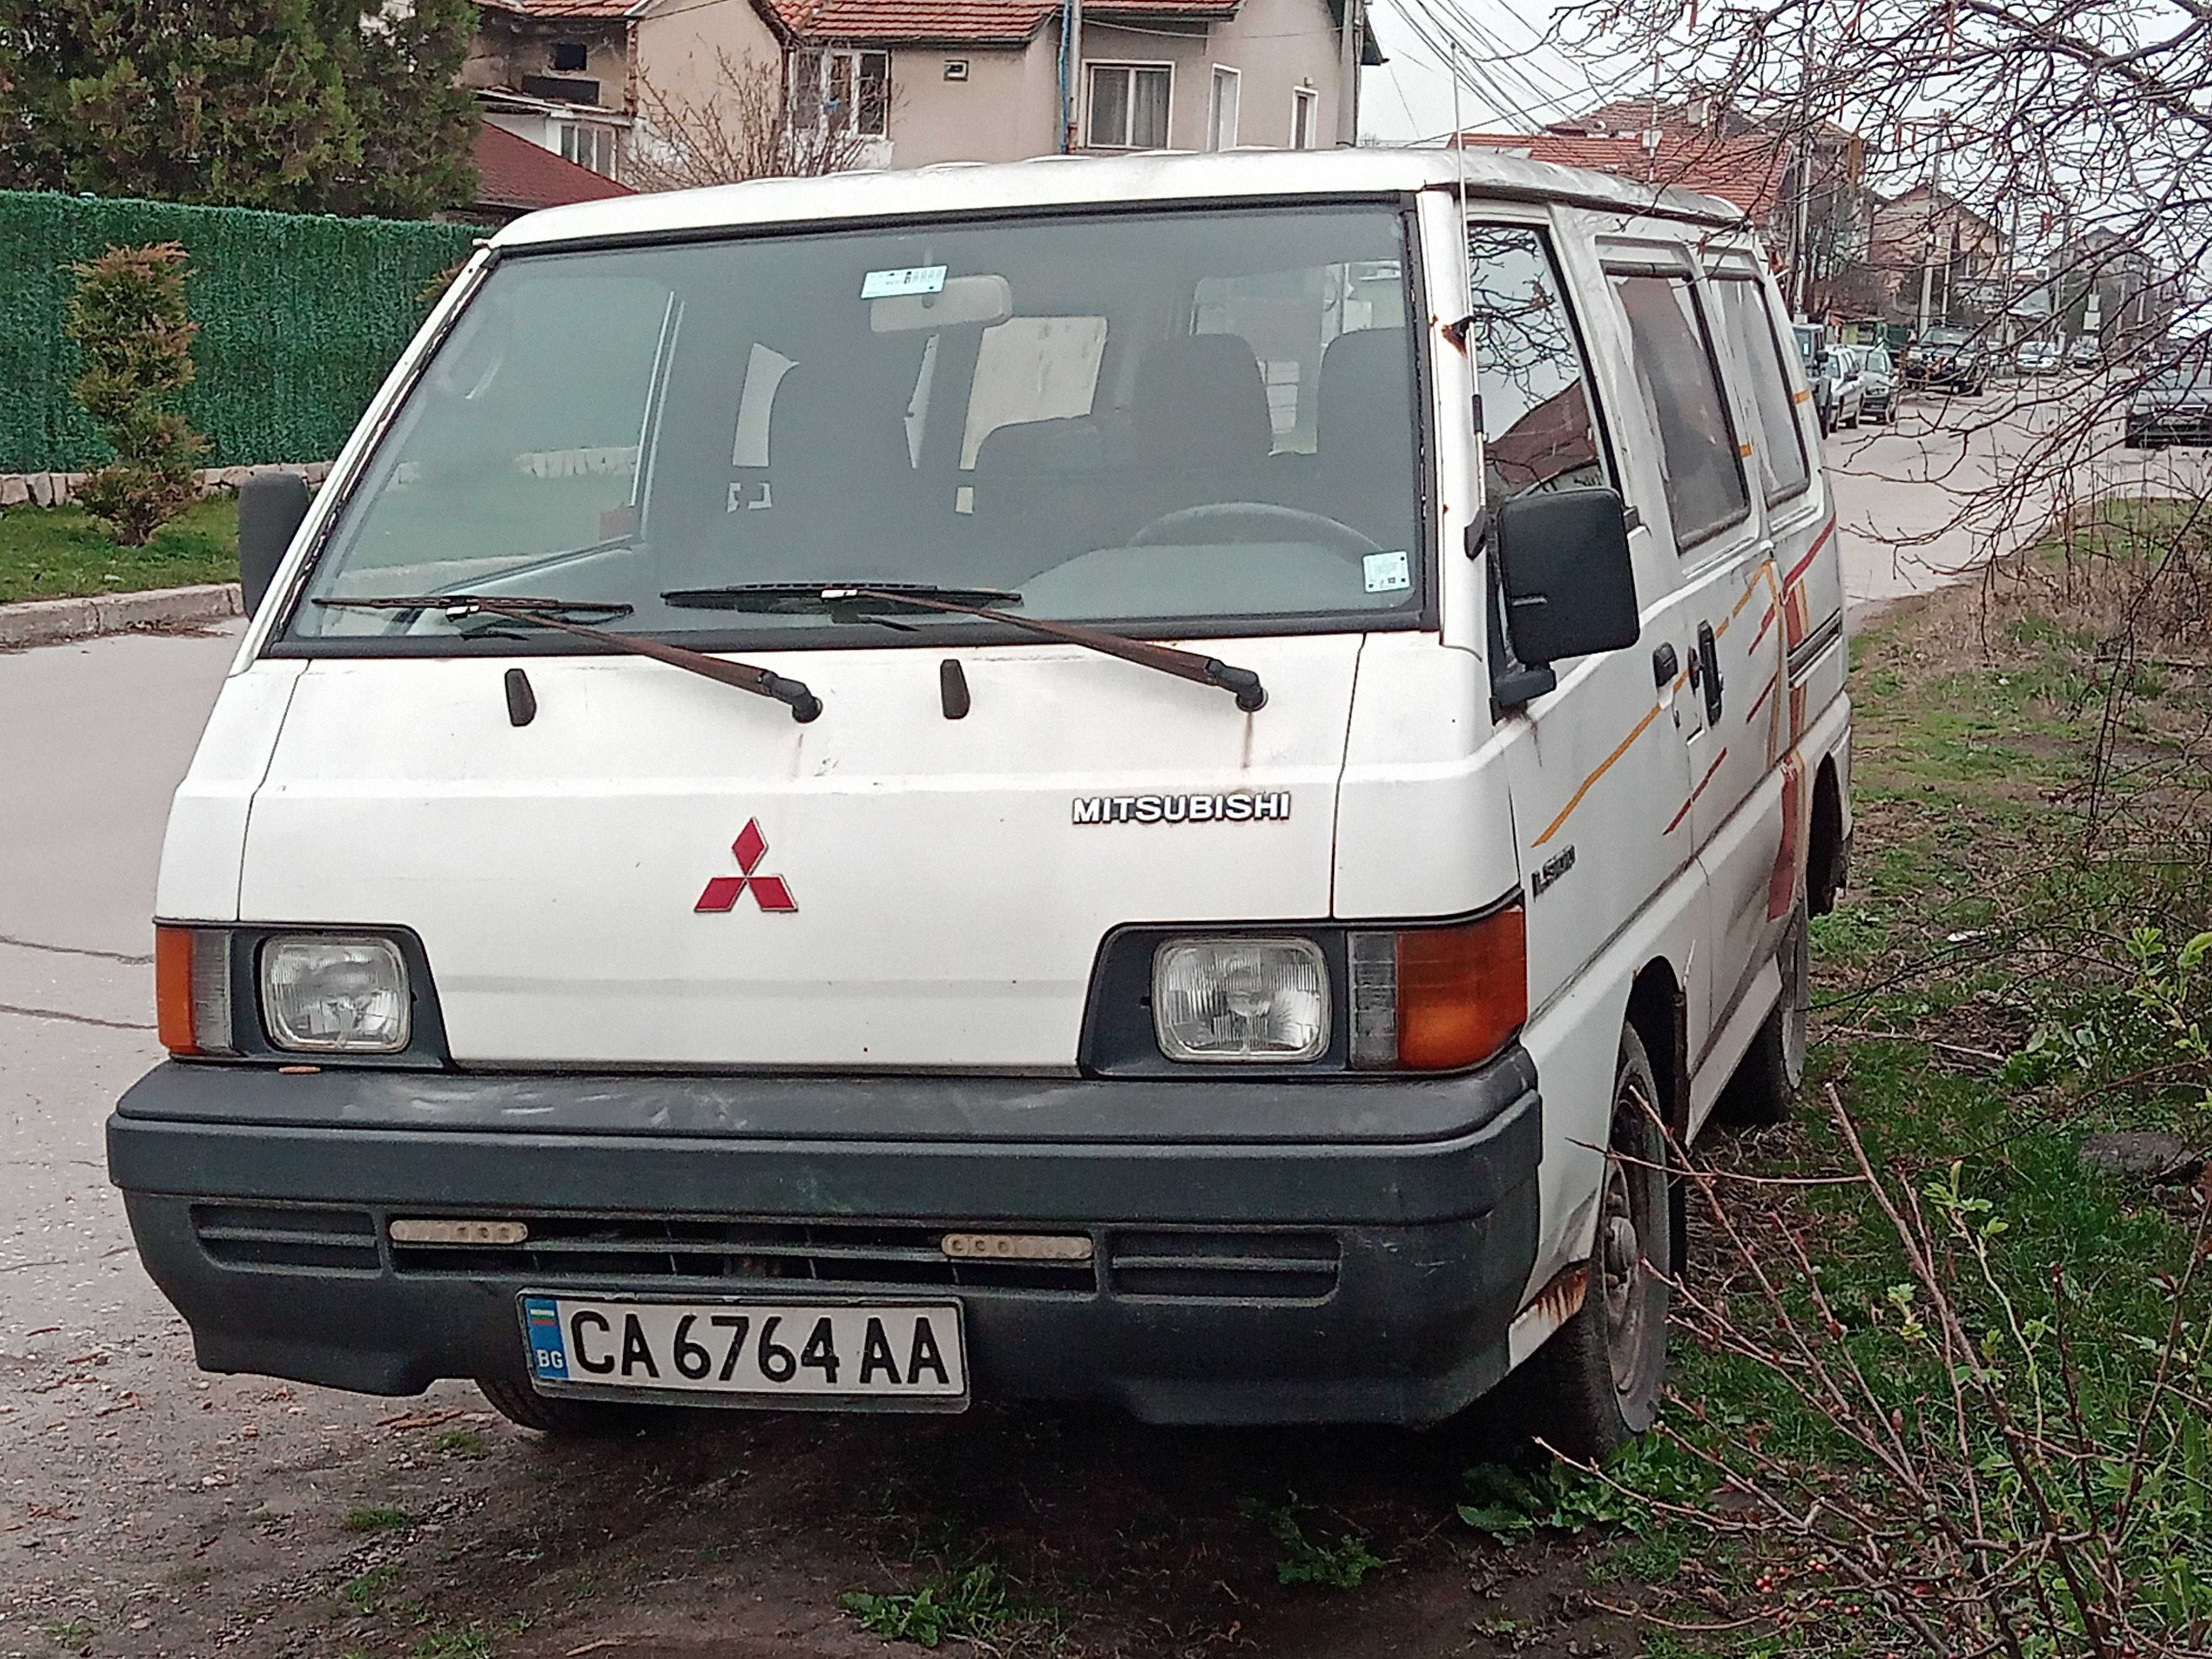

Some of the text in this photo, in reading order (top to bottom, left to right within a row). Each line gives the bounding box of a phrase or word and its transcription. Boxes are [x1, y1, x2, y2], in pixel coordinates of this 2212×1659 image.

[1073, 792, 1291, 824] MITSUBISHI
[536, 1348, 565, 1370] BG
[570, 1310, 950, 1385] CA 6764 AA
